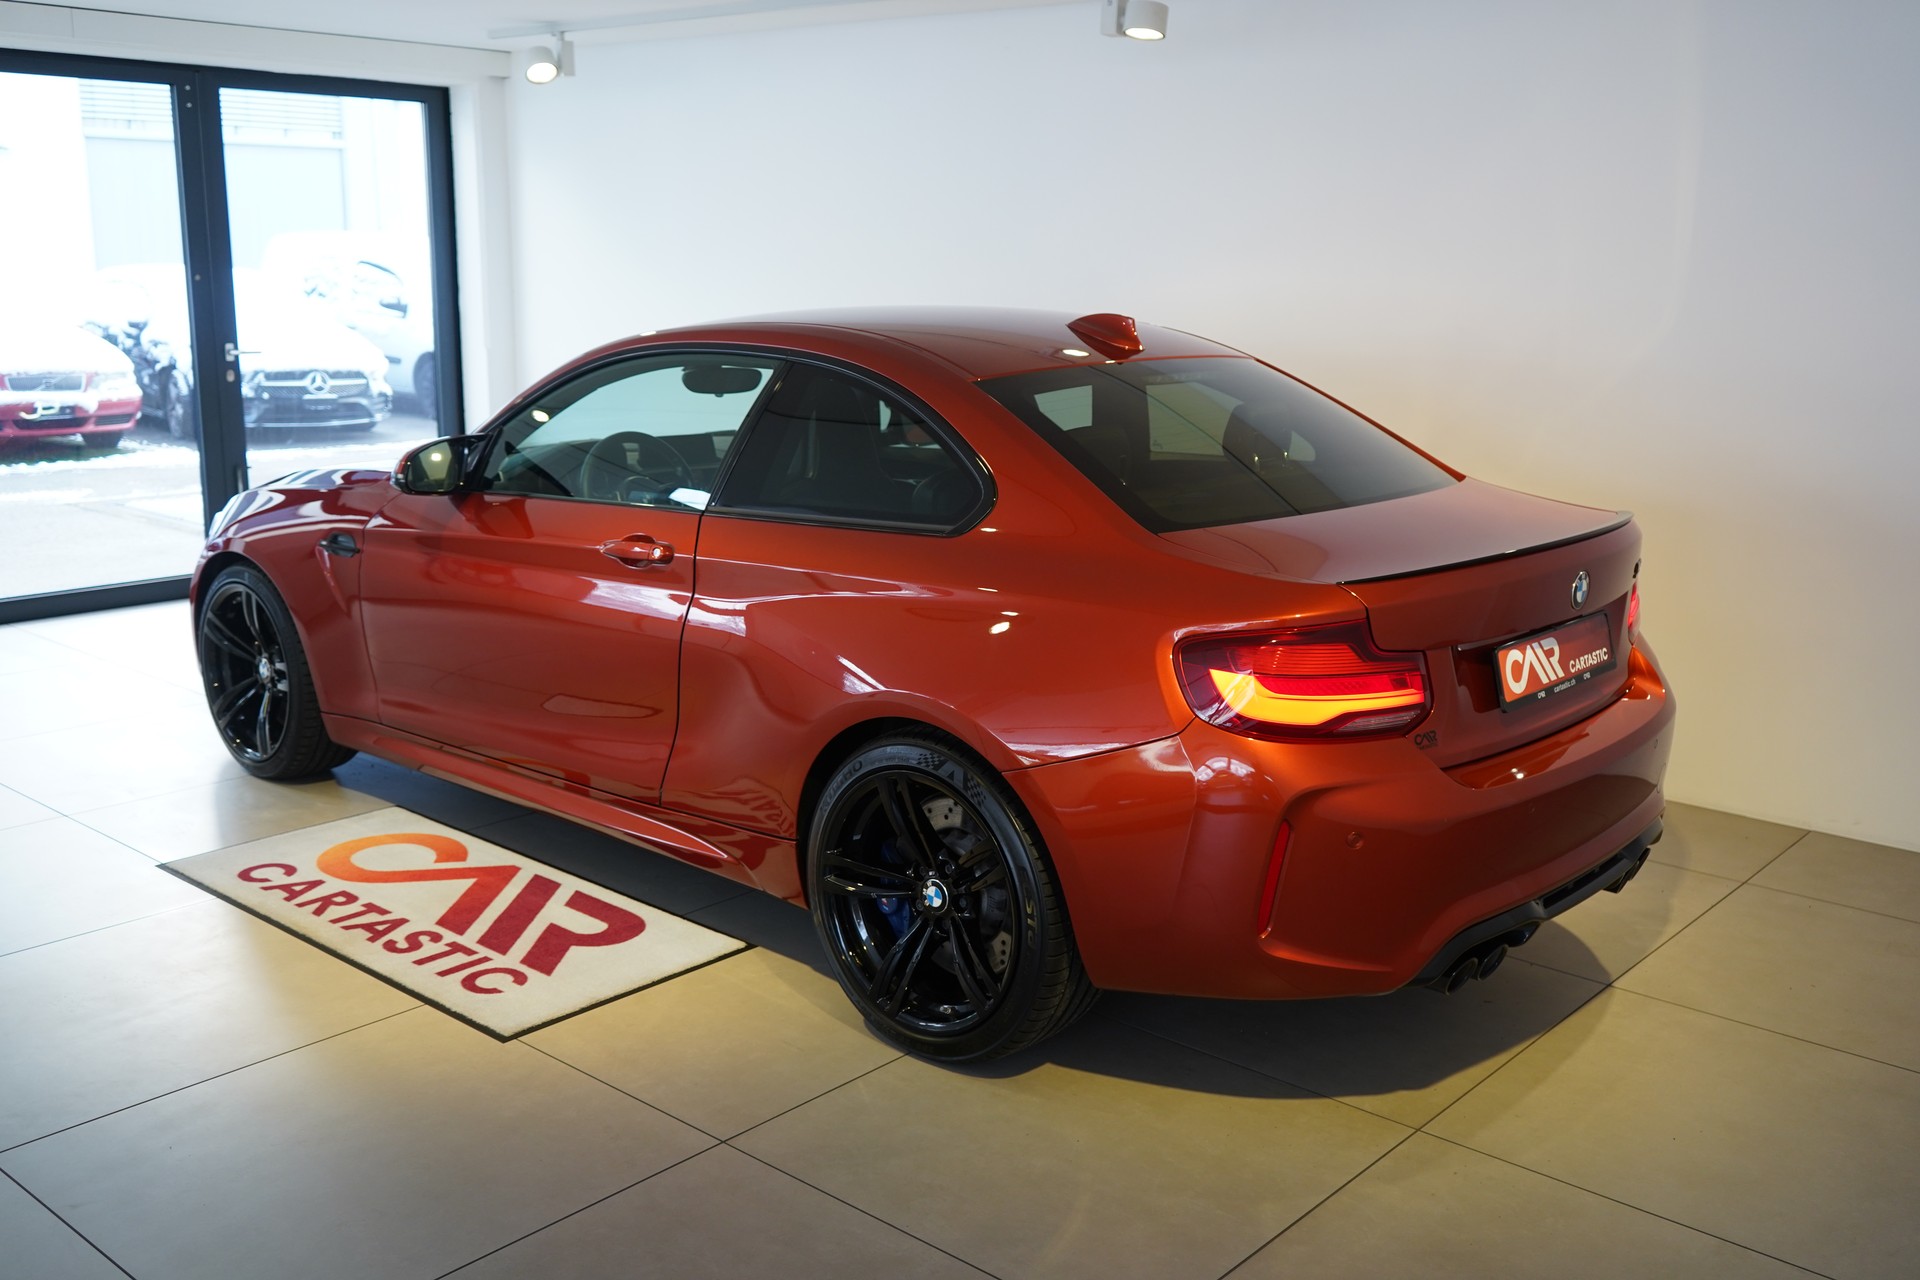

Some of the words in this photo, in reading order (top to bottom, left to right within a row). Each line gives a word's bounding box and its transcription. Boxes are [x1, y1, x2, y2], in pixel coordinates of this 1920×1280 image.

[1569, 647, 1608, 673] CARTASTIC
[1553, 678, 1576, 693] cartastic.ch
[237, 863, 527, 994] CARTASTIC
